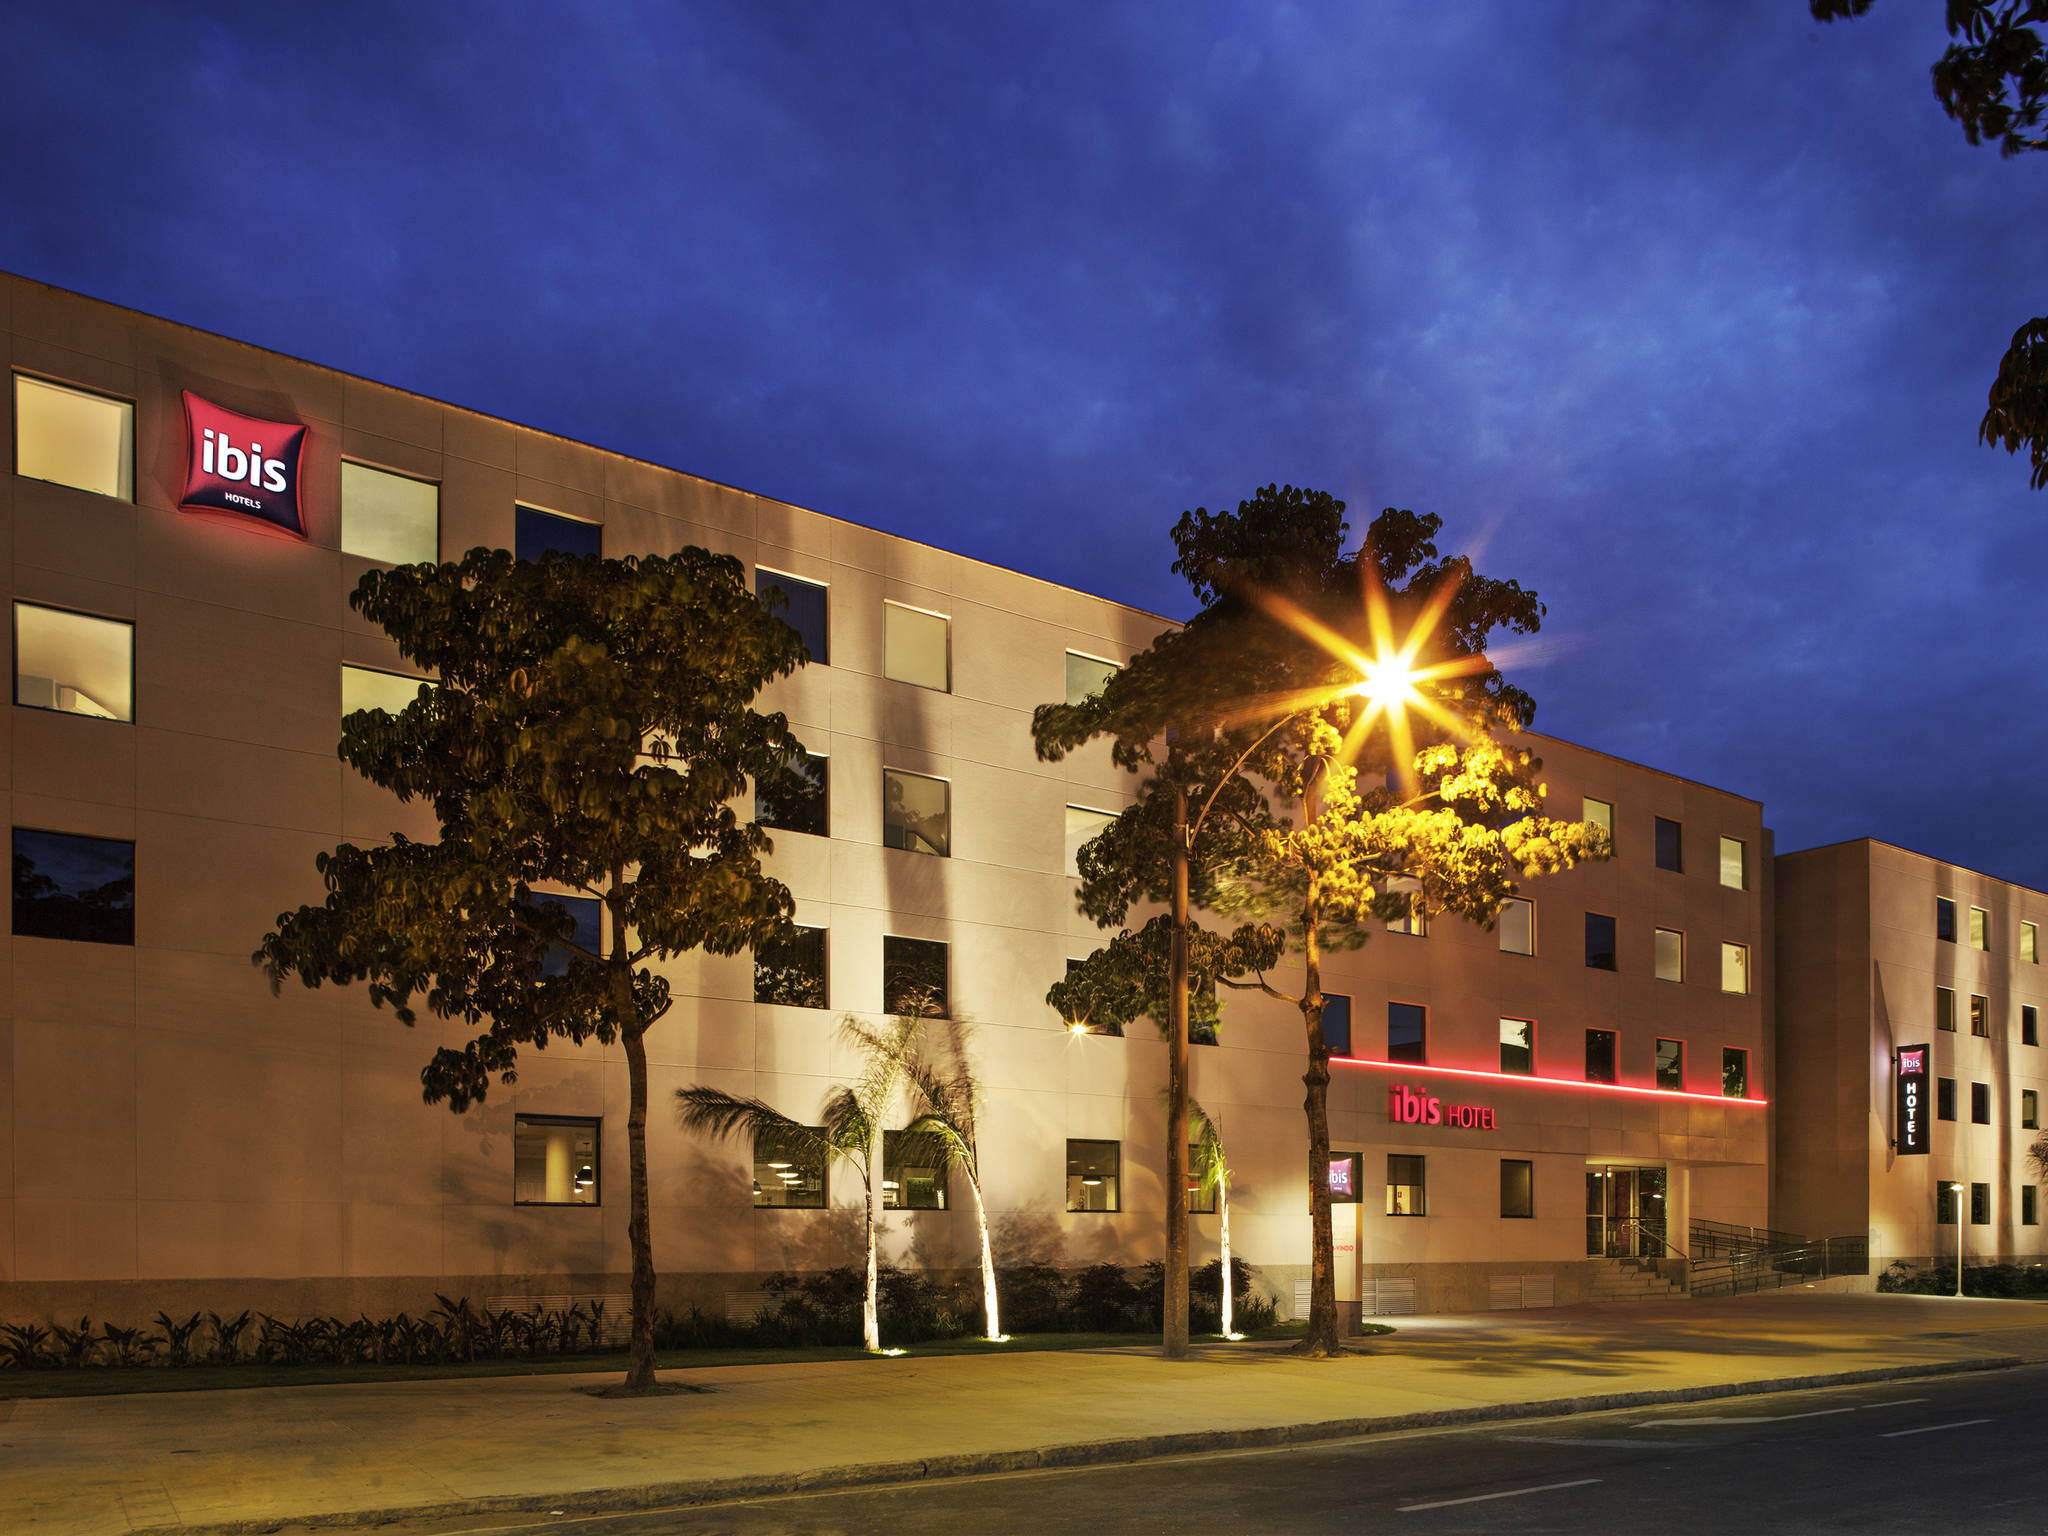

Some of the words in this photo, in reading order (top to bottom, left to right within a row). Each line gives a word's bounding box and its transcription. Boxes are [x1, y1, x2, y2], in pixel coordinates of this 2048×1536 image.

[202, 427, 287, 493] ibis
[224, 491, 262, 510] HOTELS
[1903, 1057, 1921, 1068] ibis
[1390, 1084, 1441, 1125] ibis
[1445, 1105, 1500, 1130] HOTEL
[1906, 1082, 1917, 1146] HOTEL
